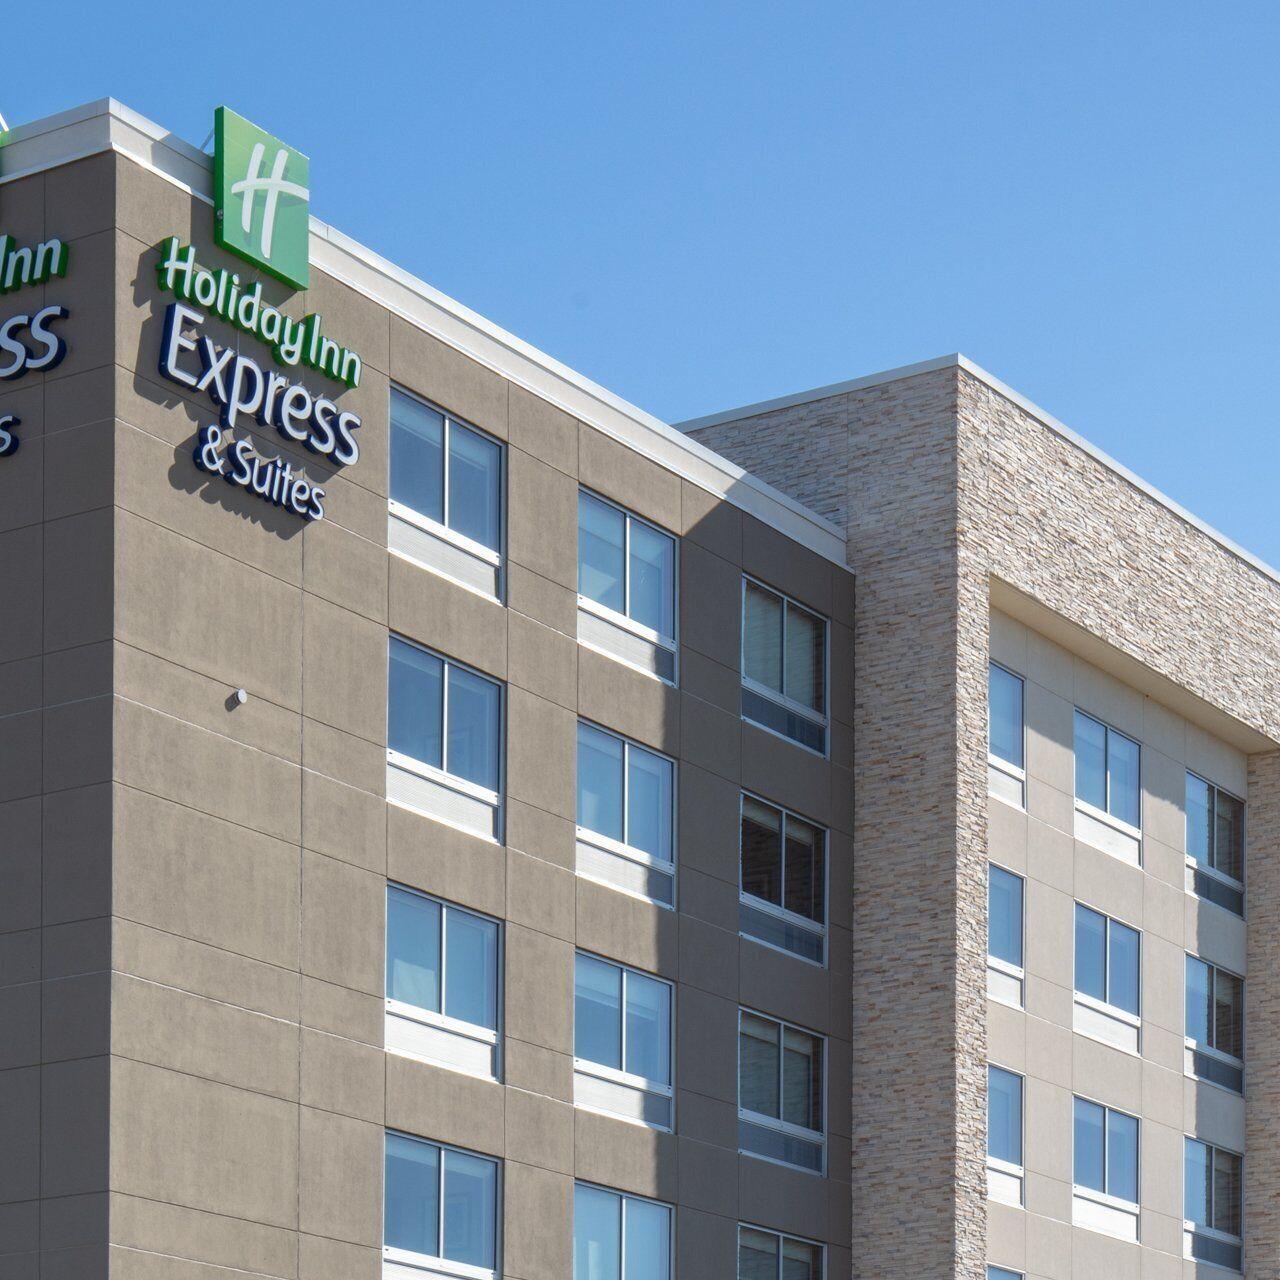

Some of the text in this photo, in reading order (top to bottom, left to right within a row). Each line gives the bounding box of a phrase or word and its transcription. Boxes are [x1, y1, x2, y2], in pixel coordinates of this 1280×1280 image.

[231, 142, 310, 259] H
[162, 235, 363, 388] Holiday Inn
[165, 302, 363, 467] Express
[200, 424, 326, 521] & Suites
